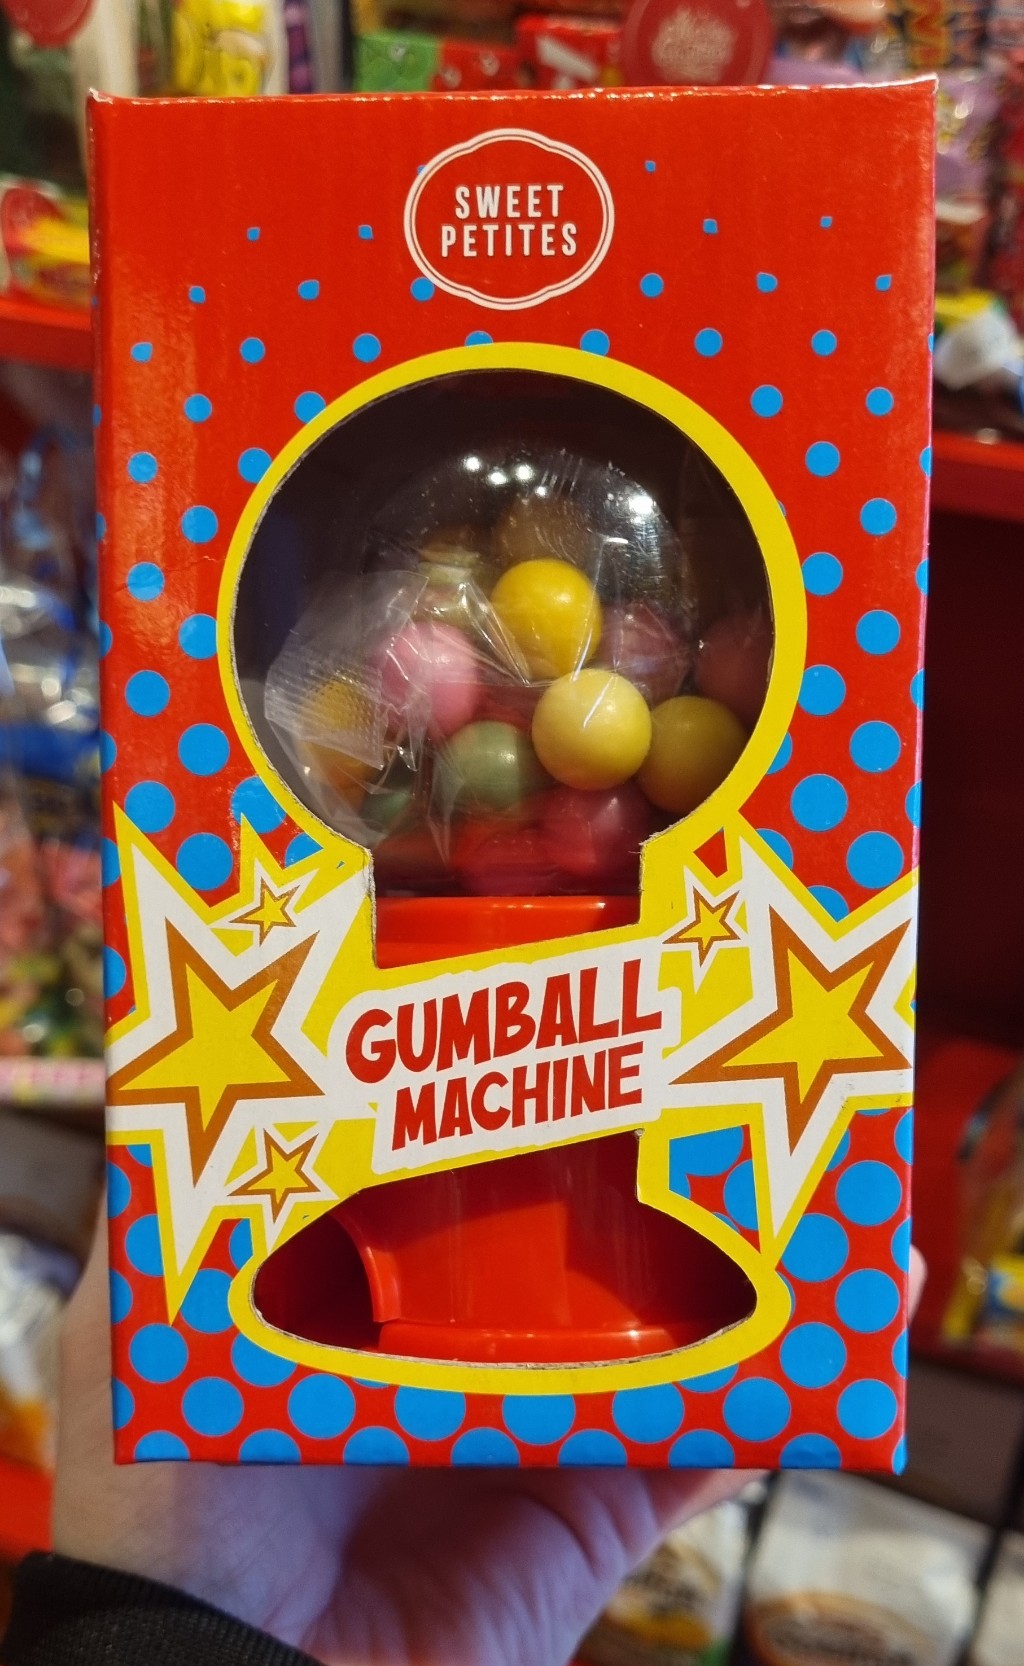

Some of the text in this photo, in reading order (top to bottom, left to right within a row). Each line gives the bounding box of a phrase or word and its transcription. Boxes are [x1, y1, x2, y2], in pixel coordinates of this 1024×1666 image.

[455, 184, 564, 219] SWEET
[441, 223, 577, 257] PETITES
[345, 958, 663, 1084] GUMBALL
[392, 1040, 644, 1151] MACHINE
